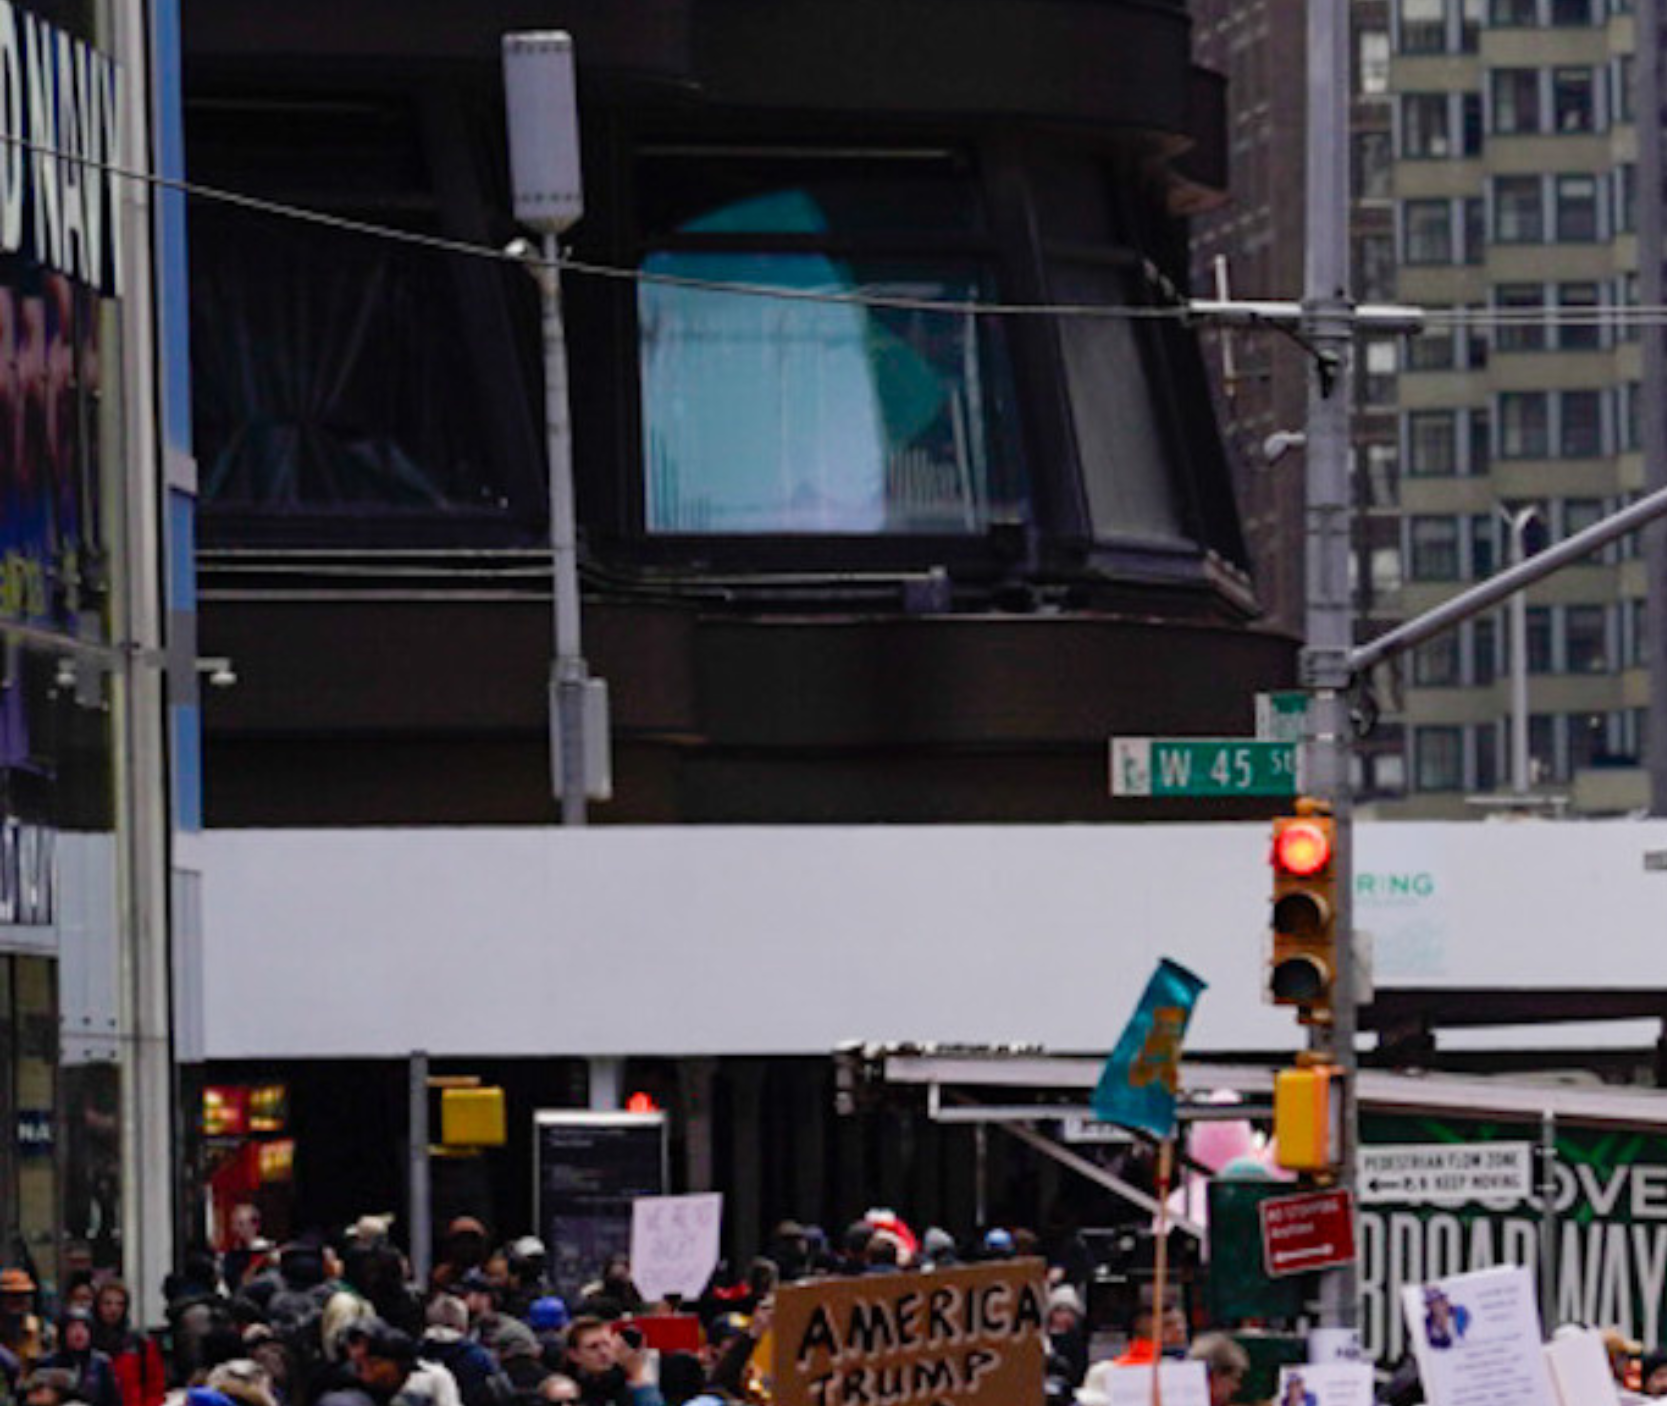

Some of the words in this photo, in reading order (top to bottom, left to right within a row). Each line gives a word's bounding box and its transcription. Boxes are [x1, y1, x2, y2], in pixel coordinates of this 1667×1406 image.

[1159, 749, 1192, 788] W
[1210, 750, 1252, 789] 45
[796, 1282, 1043, 1367] AMERICA
